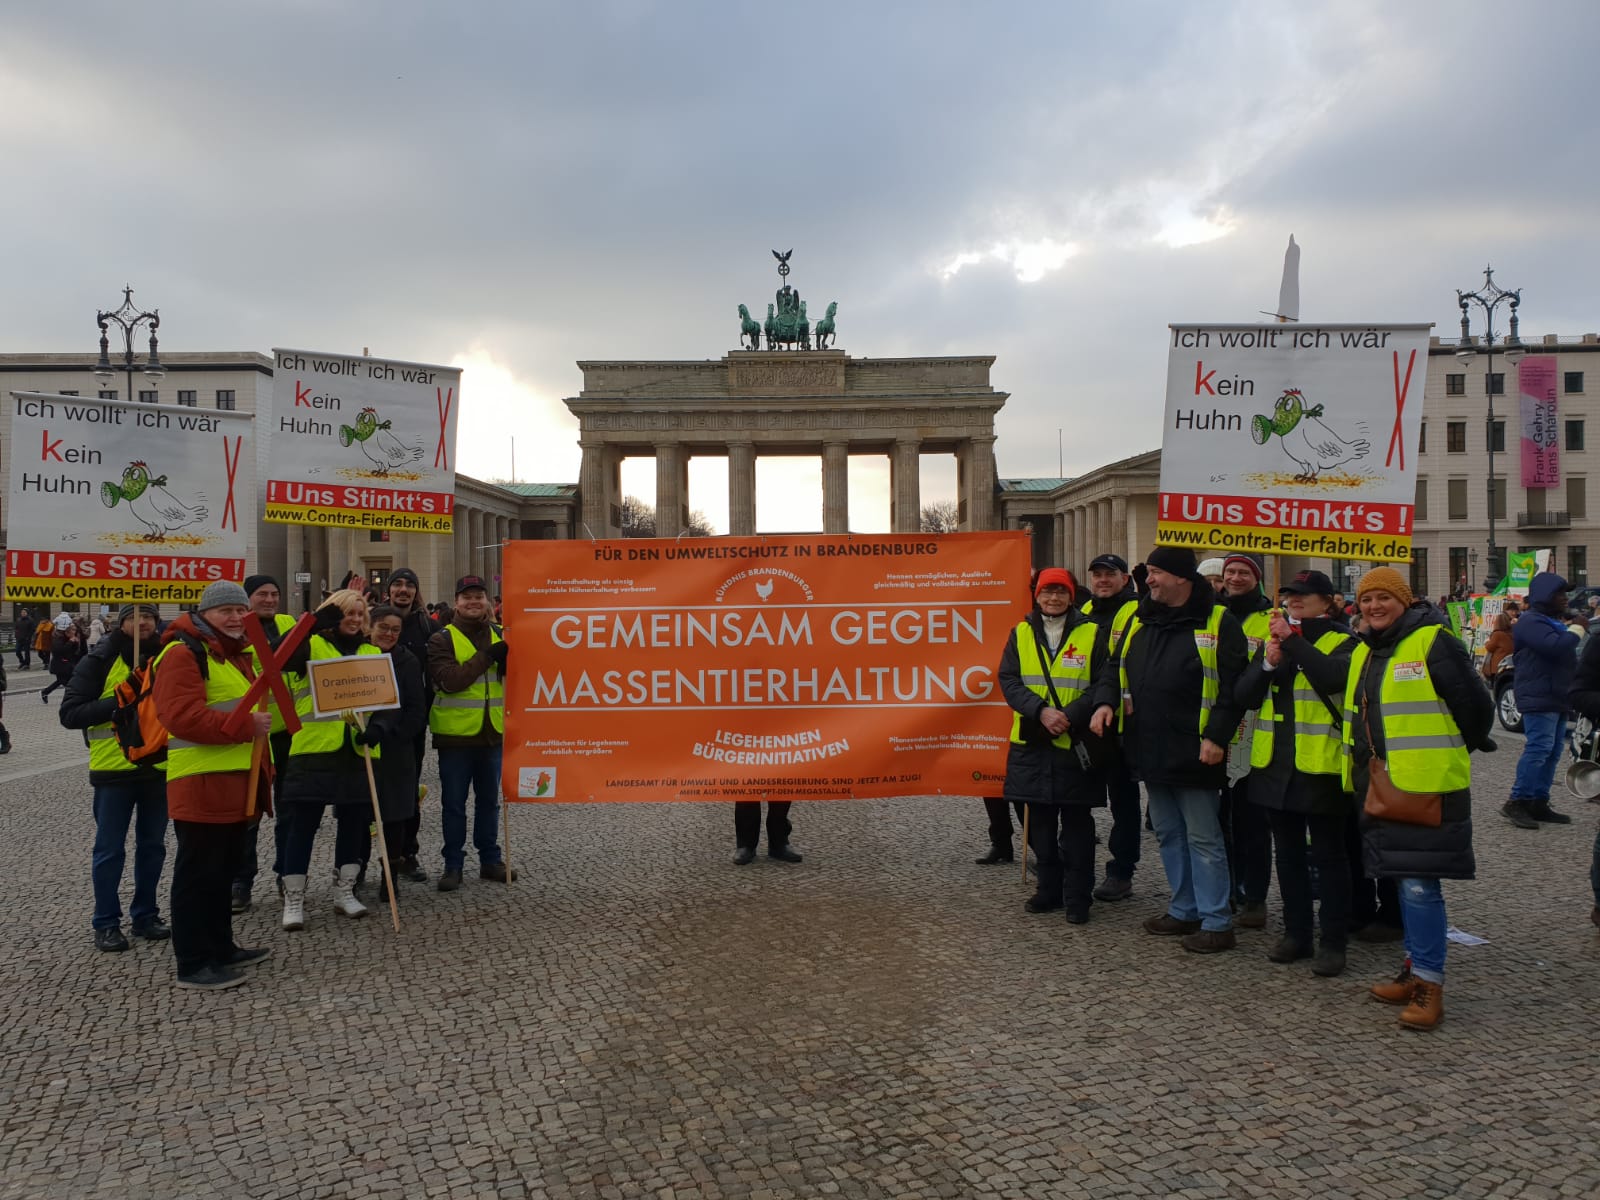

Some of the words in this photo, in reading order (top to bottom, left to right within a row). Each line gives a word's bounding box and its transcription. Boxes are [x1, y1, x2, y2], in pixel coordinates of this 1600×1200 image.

[1173, 329, 1209, 348] Ich
[1293, 329, 1330, 348] ich
[1340, 328, 1391, 348] wär
[277, 353, 306, 371] Ich
[368, 362, 395, 381] ich
[401, 369, 436, 385] wär
[16, 398, 55, 419] Ich
[136, 408, 170, 429] ich
[178, 415, 221, 433] wär
[280, 416, 332, 436] Huhn
[1175, 409, 1242, 431] Huhn
[1533, 403, 1545, 443] Gehry
[1544, 388, 1557, 448] Scharoun
[1533, 447, 1545, 484] Frank
[1546, 451, 1558, 484] Hans
[22, 472, 91, 495] Huhn
[270, 482, 277, 501] !
[286, 483, 335, 506] Uns
[443, 495, 450, 513] !
[266, 509, 451, 531] www.Contra-Eierfabrik.de
[1162, 494, 1170, 519] !
[1182, 495, 1243, 523] Uns
[1398, 506, 1408, 533] !
[594, 545, 622, 561] FÜR
[628, 548, 660, 561] DEN
[665, 545, 788, 561] UMWELTSCHUTZ
[794, 545, 811, 557] IN
[817, 542, 938, 557] BRANDENBURG
[1158, 528, 1409, 560] www.Contra-Eierfabrik.de
[10, 552, 19, 575] !
[33, 553, 96, 576] Uns
[233, 560, 241, 579] !
[715, 571, 746, 602] BÜNDNIS
[748, 568, 814, 601] BRANDENBURGER
[550, 610, 814, 649] GEMEINSAM
[830, 607, 984, 646] GEGEN
[322, 673, 386, 688] Oranienburg
[333, 687, 377, 700] Zehlendorf
[532, 665, 994, 705] MASSENTIERHALTUNG
[692, 738, 850, 766] BÜRGERINITIATIVEN
[715, 728, 822, 749] LEGEHENNEN
[606, 779, 658, 788] LANDESAMT
[661, 778, 677, 787] FÜR
[681, 778, 716, 786] UMWELT
[720, 778, 739, 786] UND
[742, 777, 829, 786] LANDESREGIERUNG
[832, 777, 853, 785] SIND
[856, 776, 880, 785] JETZT
[882, 775, 897, 783] AM
[900, 773, 922, 782] ZUG!
[680, 788, 700, 796] MEHR
[703, 788, 721, 796] AUF:
